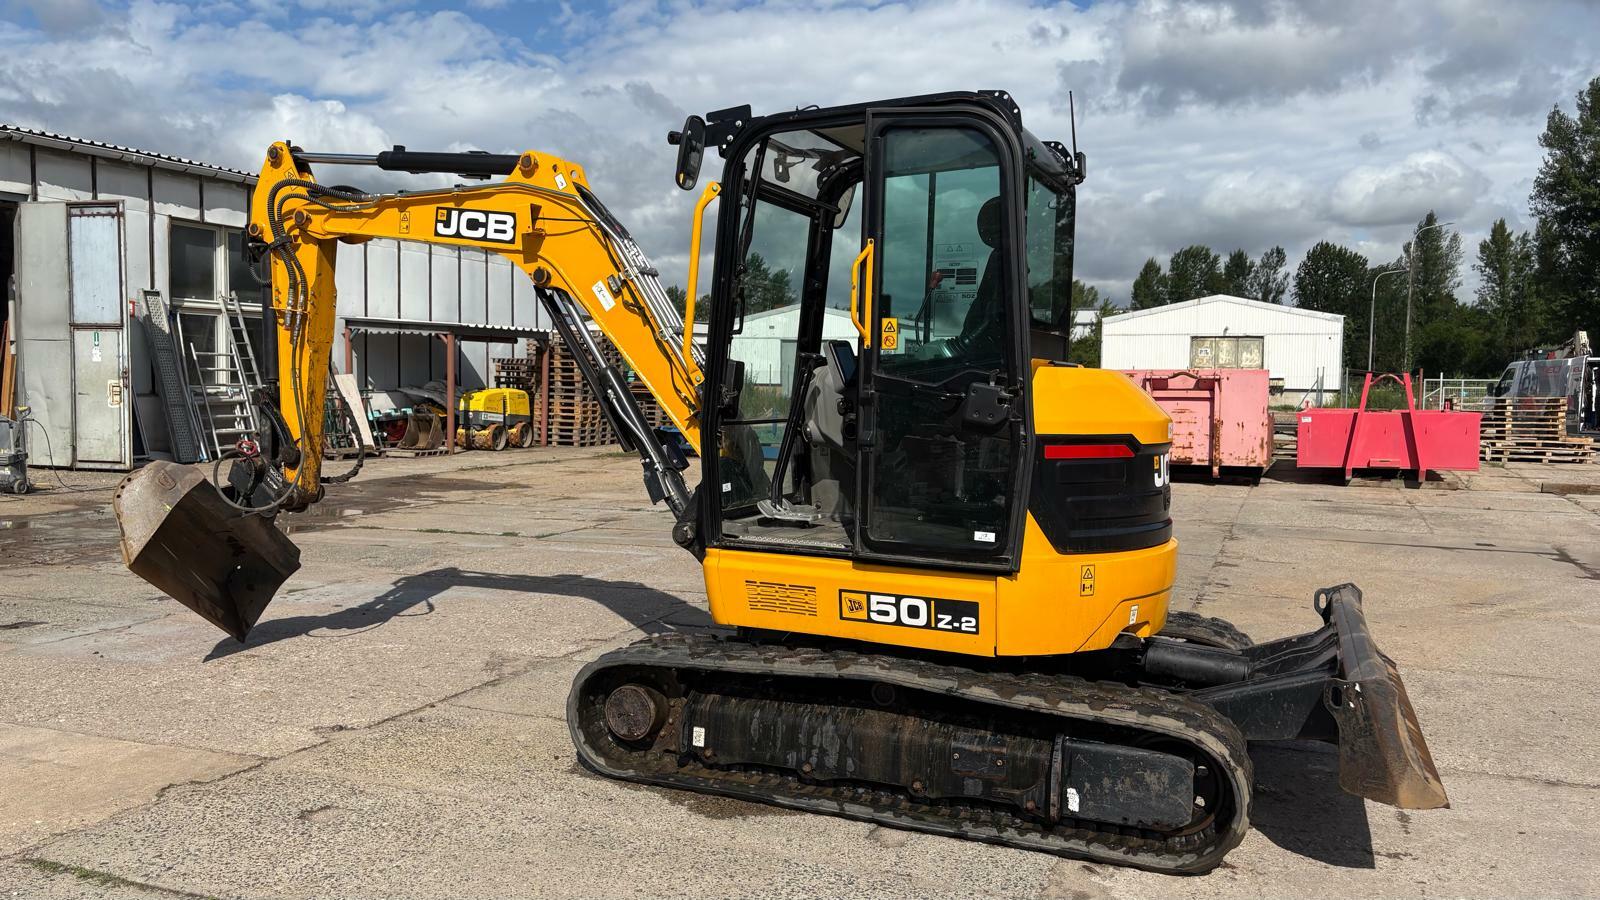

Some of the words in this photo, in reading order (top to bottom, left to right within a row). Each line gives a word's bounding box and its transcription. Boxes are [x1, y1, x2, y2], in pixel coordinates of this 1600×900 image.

[436, 210, 515, 241] JCB
[847, 598, 864, 614] JCB
[869, 594, 928, 627] 50
[937, 613, 977, 632] Z-2
